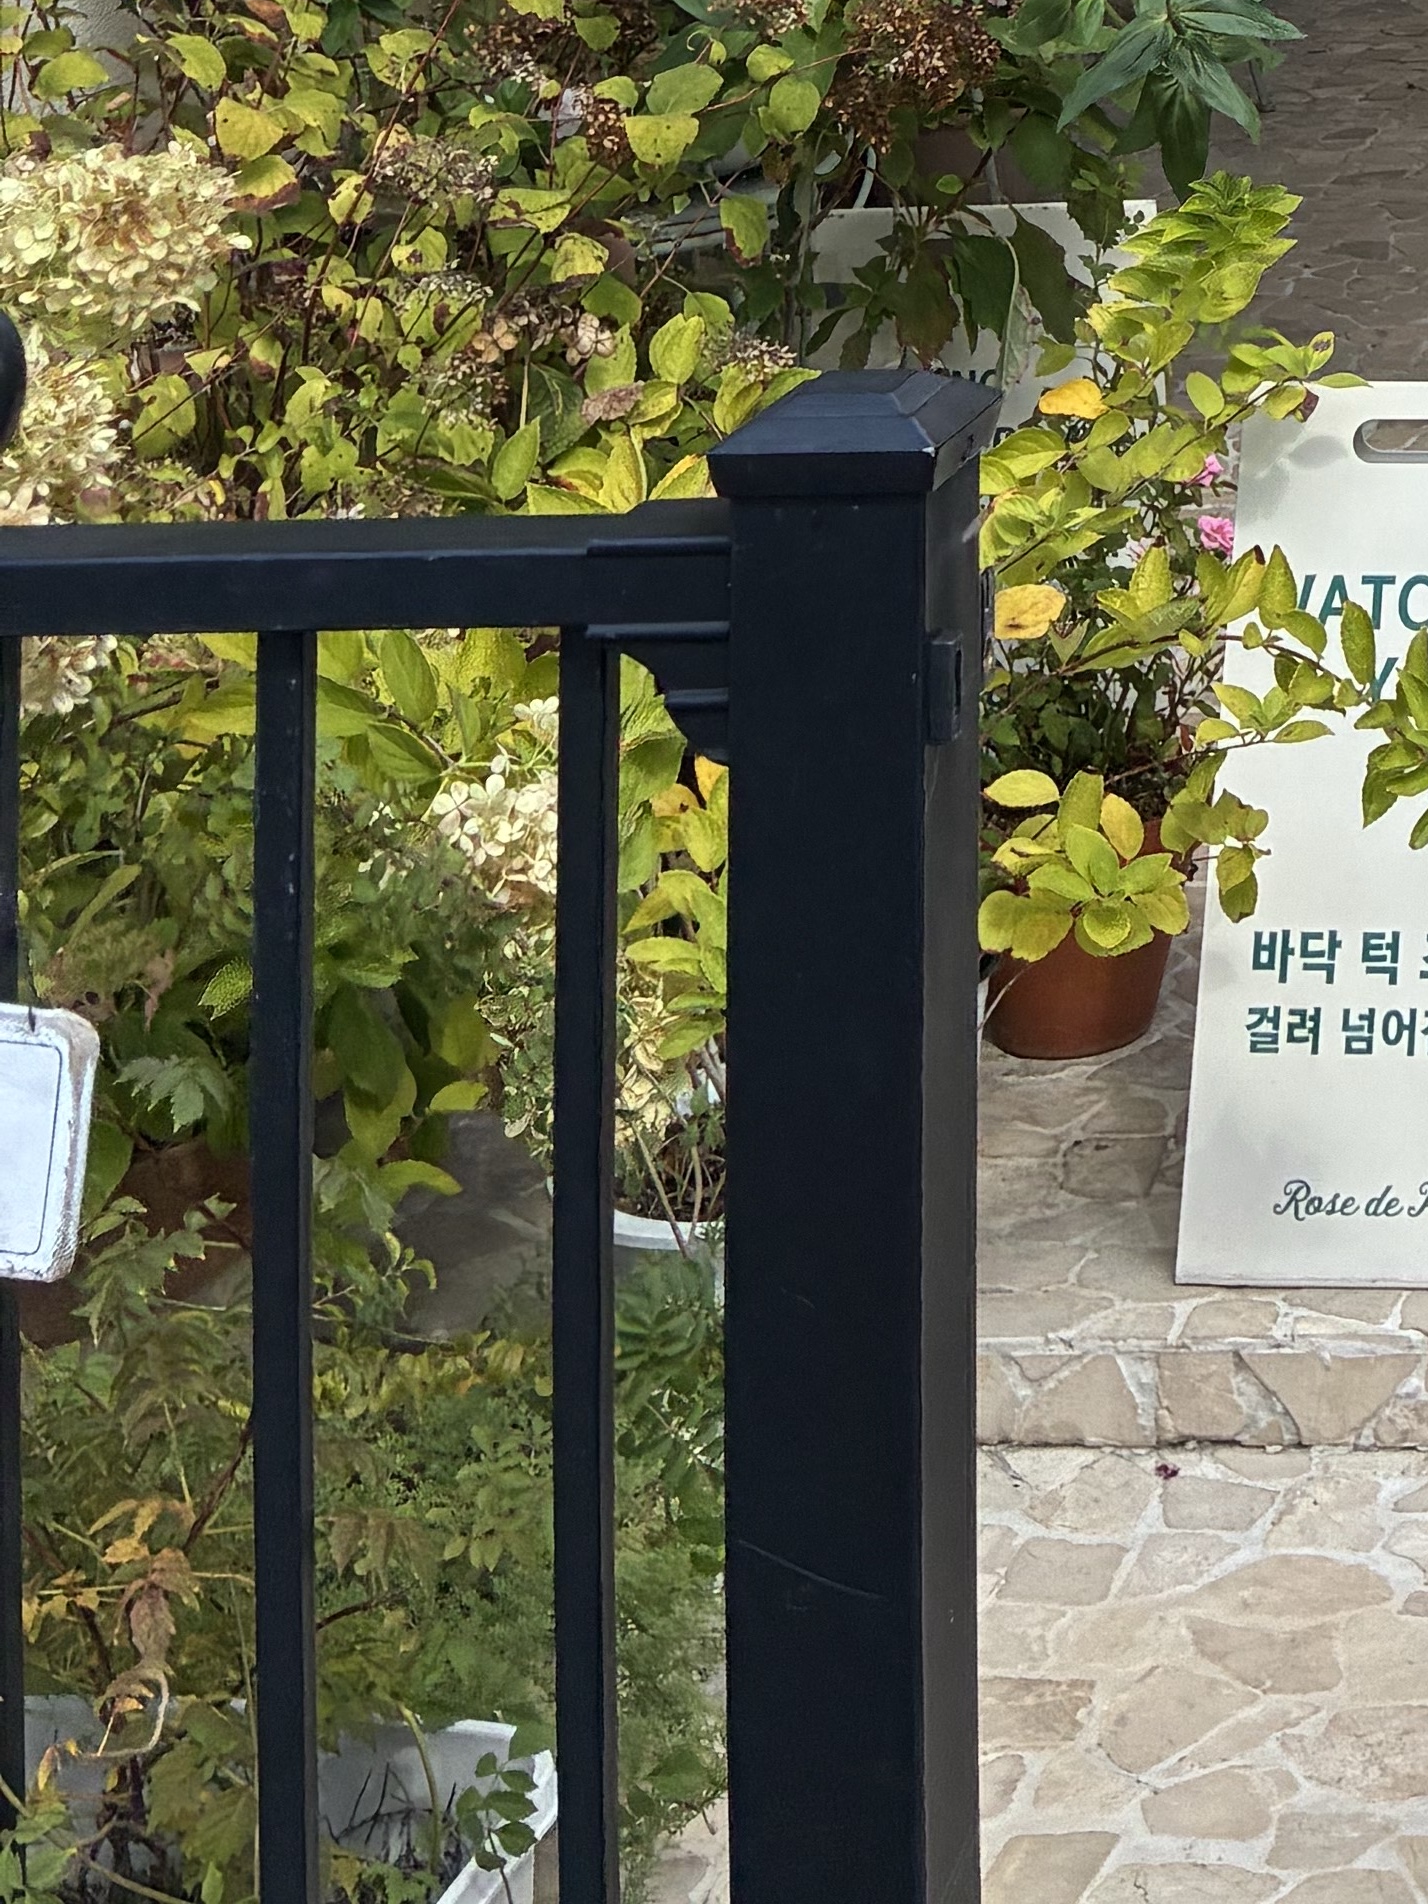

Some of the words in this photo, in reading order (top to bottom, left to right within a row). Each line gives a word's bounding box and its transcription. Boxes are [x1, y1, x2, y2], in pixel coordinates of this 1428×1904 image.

[1251, 928, 1342, 985] 바닥
[1360, 930, 1400, 985] 턱
[1245, 1005, 1322, 1056] 걸려
[1272, 1178, 1361, 1222] Rose
[1364, 1184, 1404, 1218] de
